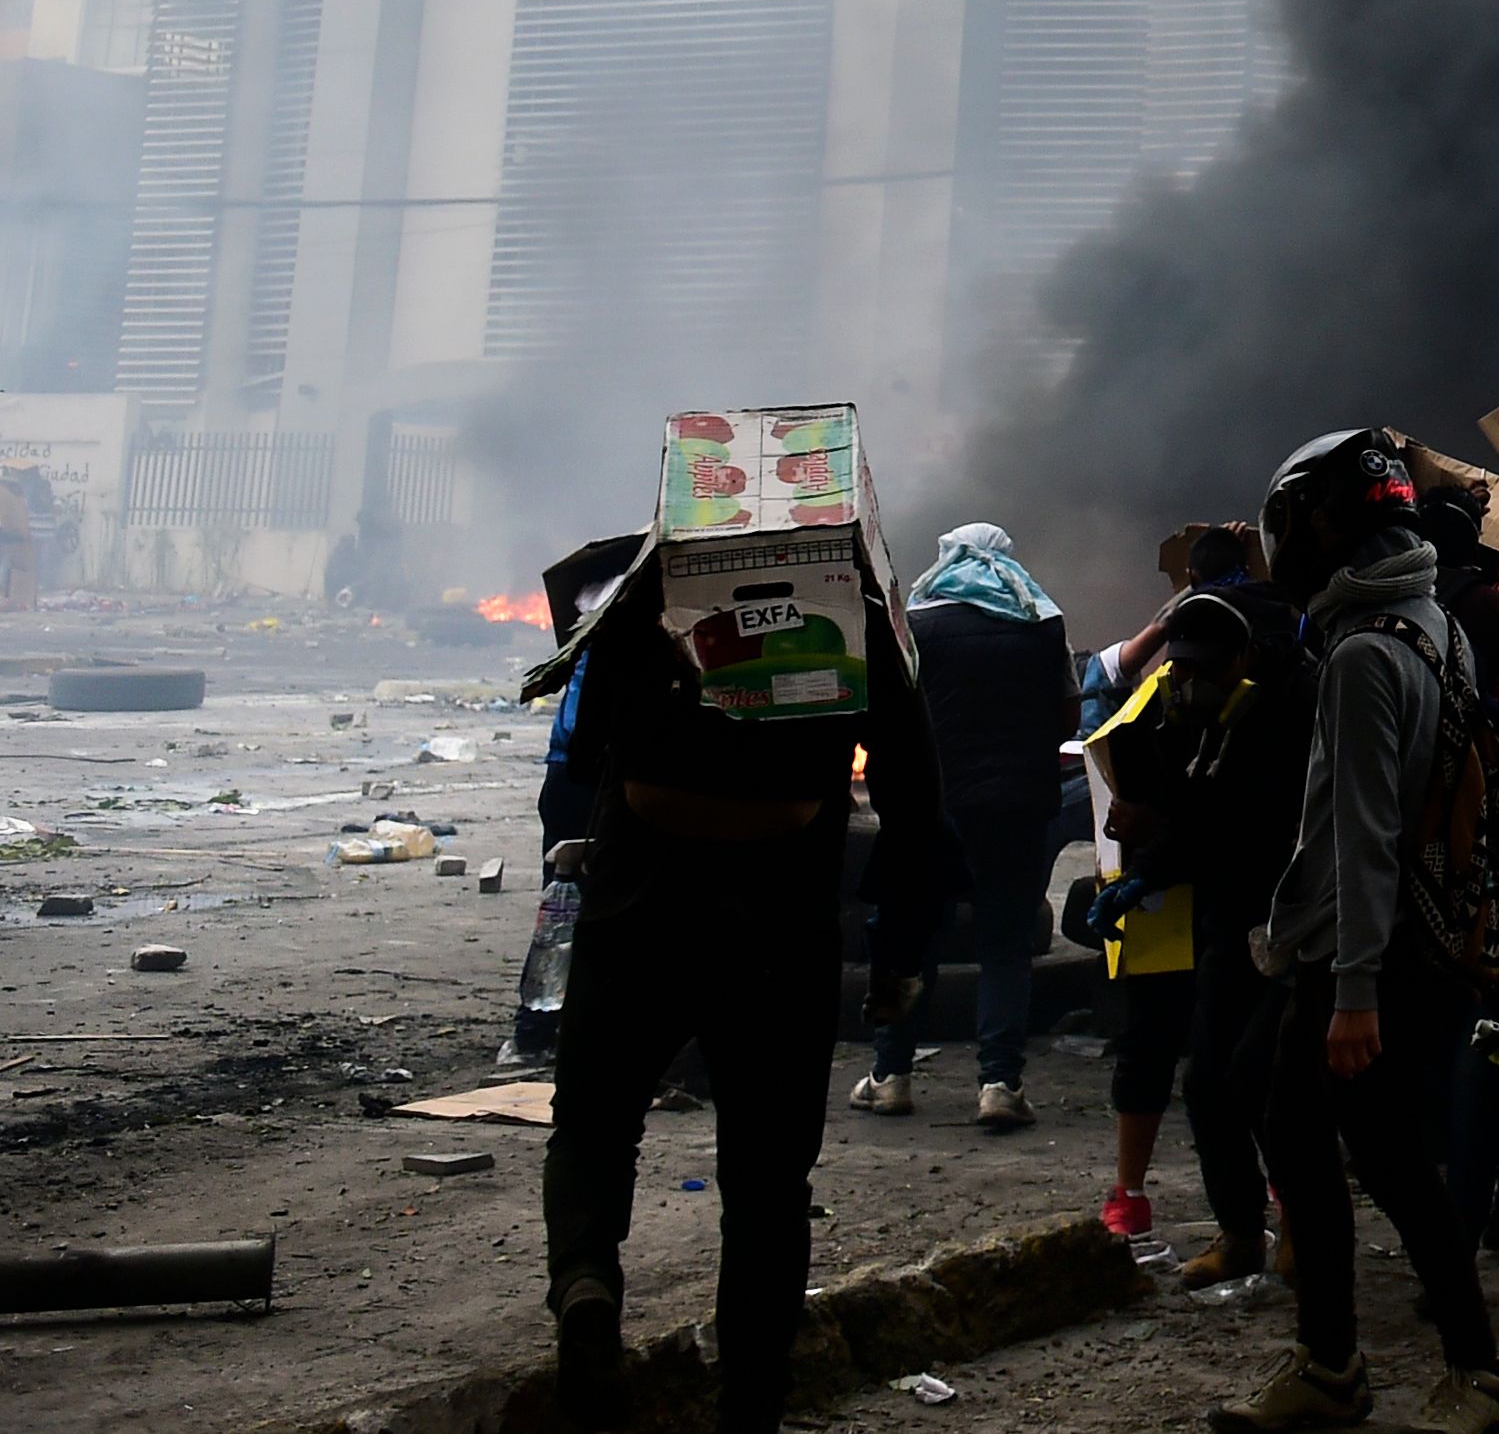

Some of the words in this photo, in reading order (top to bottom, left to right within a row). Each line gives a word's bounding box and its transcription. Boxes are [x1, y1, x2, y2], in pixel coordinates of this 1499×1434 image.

[688, 453, 722, 499] Apples
[801, 448, 834, 491] Apples
[741, 603, 801, 629] EXFA
